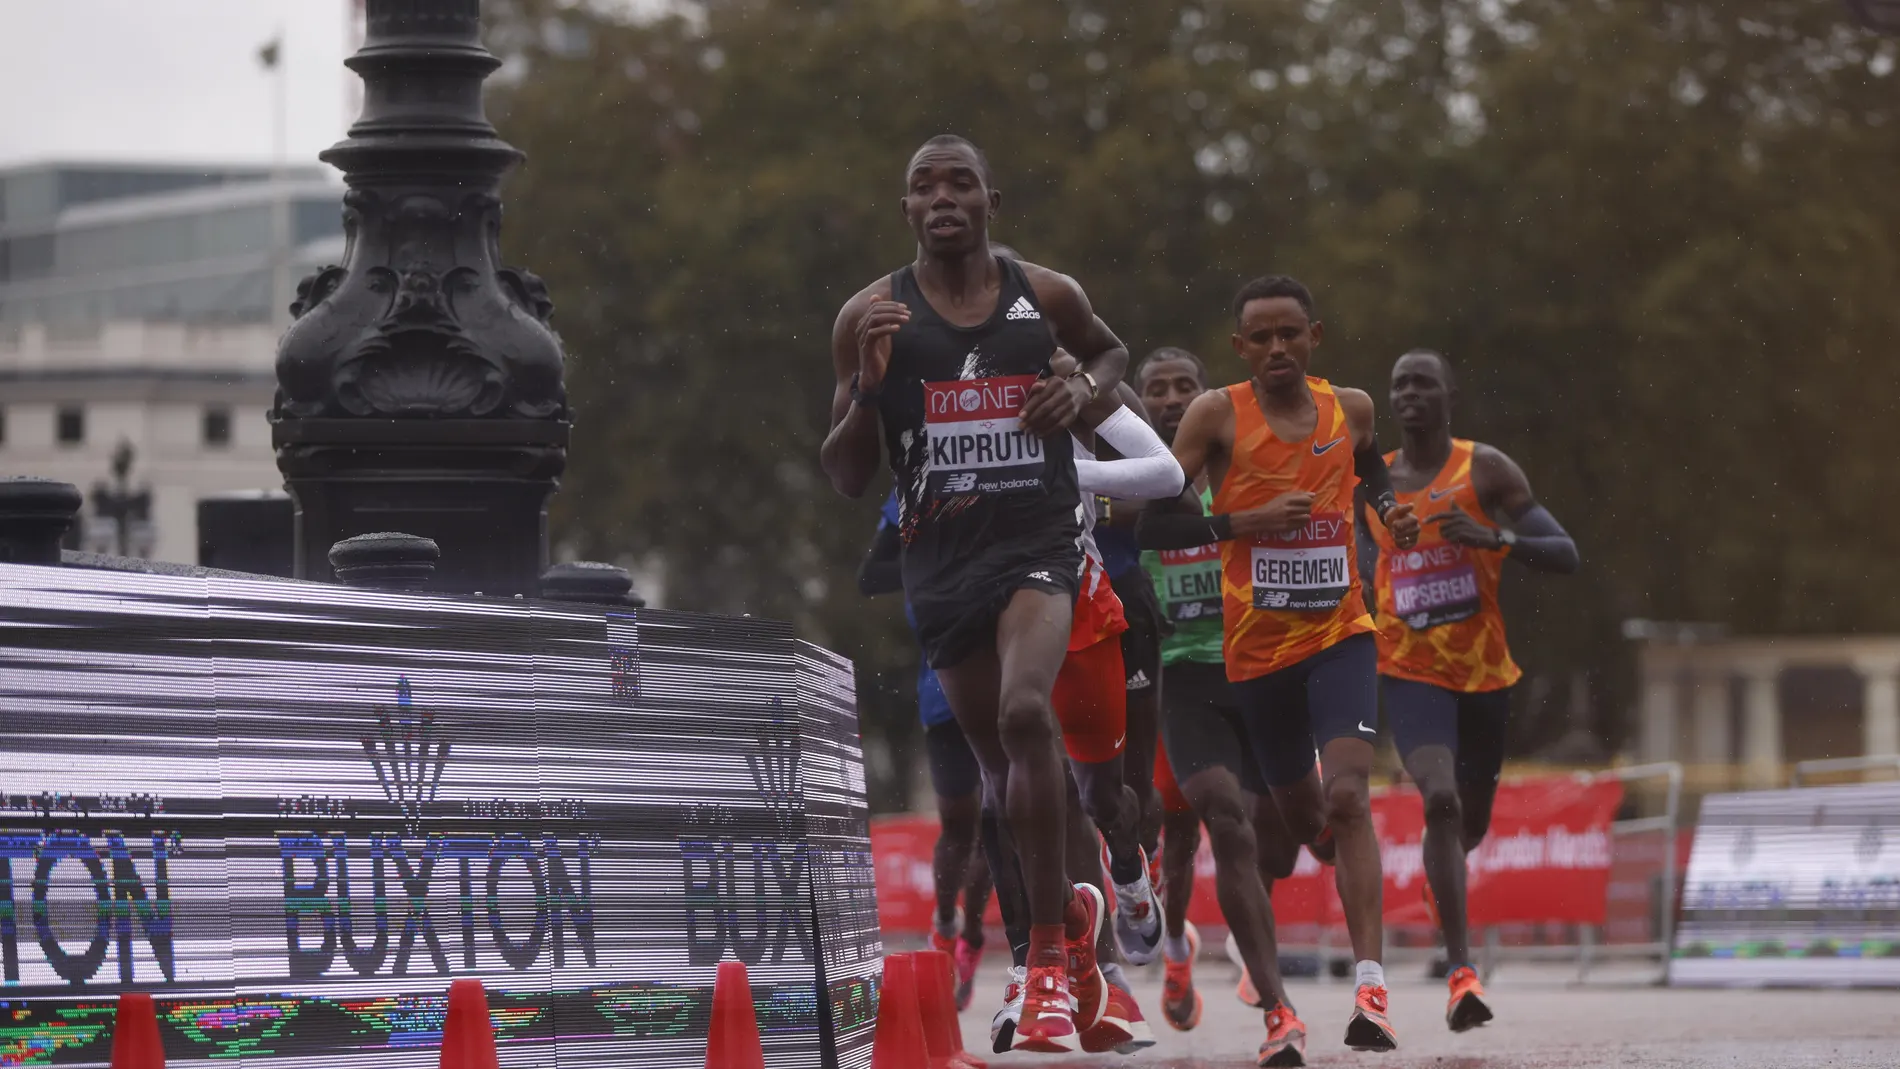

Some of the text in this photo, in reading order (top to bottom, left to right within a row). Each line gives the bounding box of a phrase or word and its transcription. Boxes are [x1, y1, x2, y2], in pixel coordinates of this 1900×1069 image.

[1006, 311, 1040, 320] adidas
[932, 430, 1040, 466] KIPRUTO
[978, 481, 998, 491] new
[1000, 479, 1039, 489] balance
[1256, 557, 1344, 585] GEREMEW
[1395, 573, 1477, 611] KIPSEREM
[275, 831, 597, 978] BUXTON
